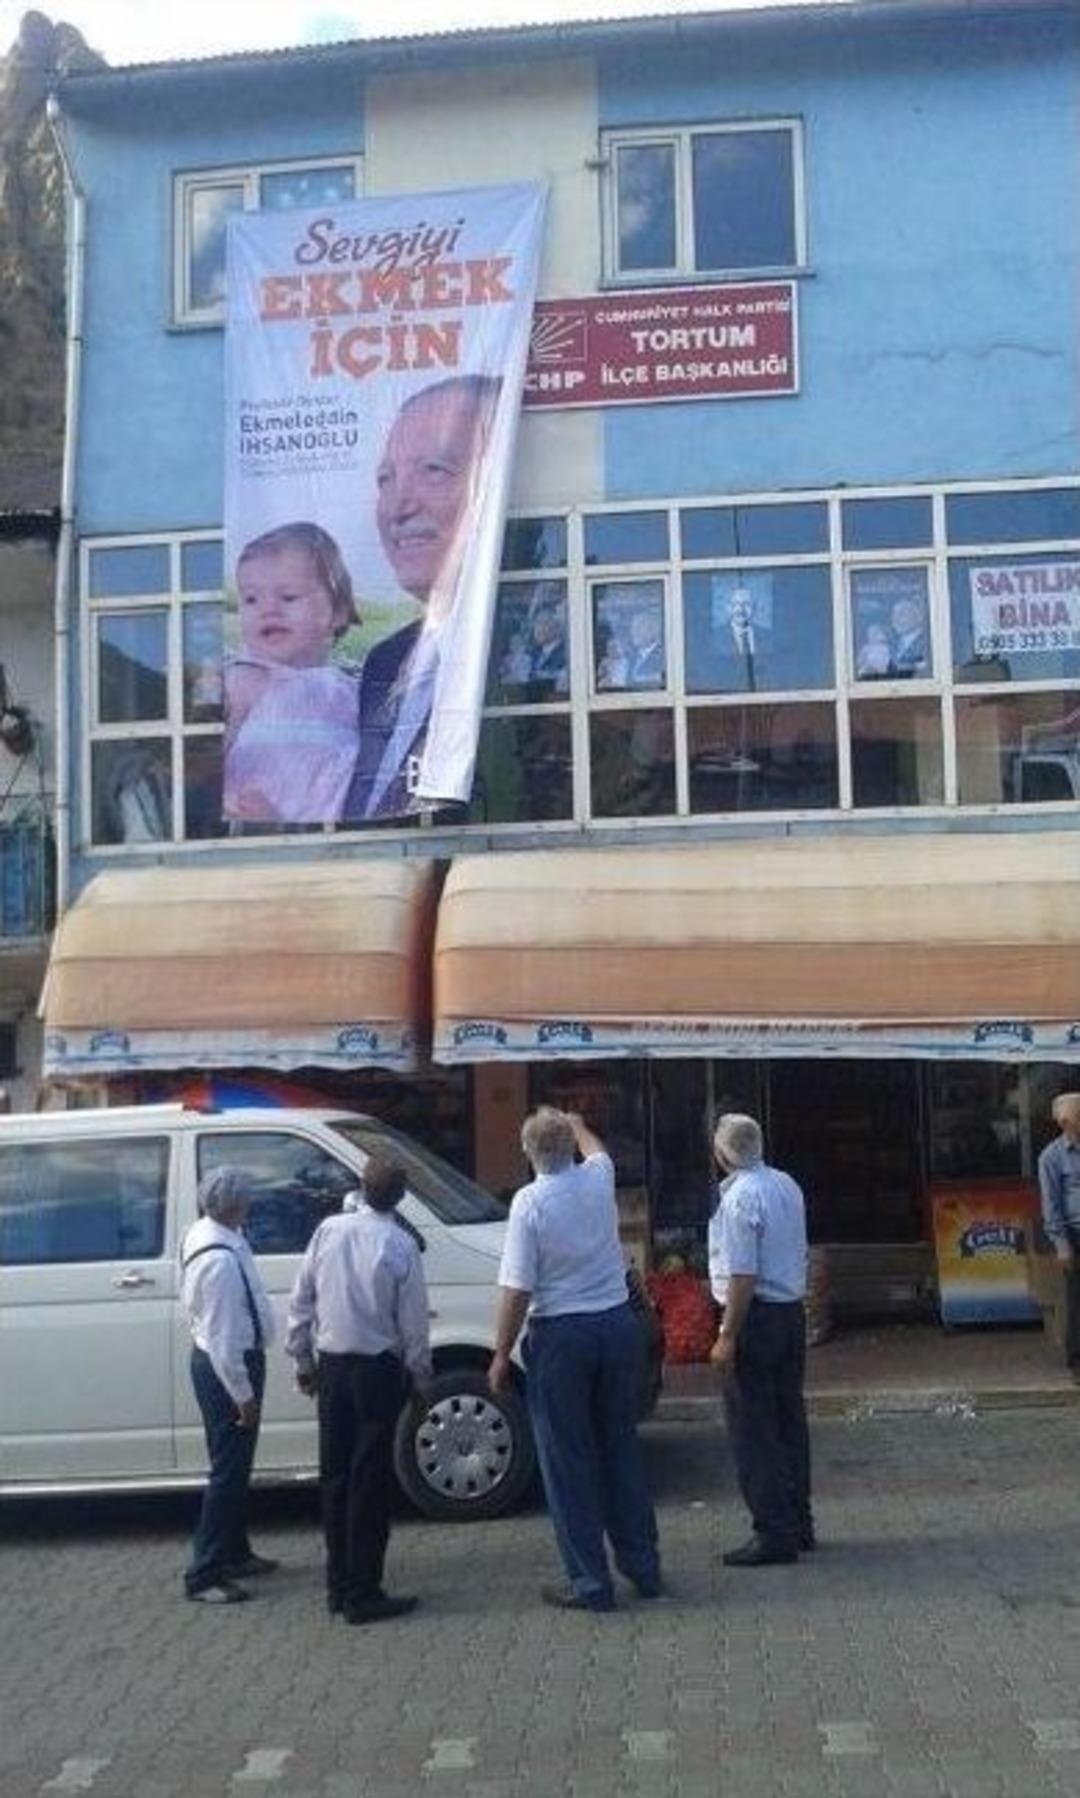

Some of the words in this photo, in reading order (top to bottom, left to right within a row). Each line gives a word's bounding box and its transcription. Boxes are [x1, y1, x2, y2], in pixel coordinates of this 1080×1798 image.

[294, 217, 466, 281] Sevgiyi
[260, 256, 515, 322] EKMEK
[693, 302, 733, 317] HALK
[310, 314, 463, 379] İÇİN
[630, 323, 756, 353] TORTUM
[602, 362, 649, 386] İLÇE
[656, 353, 788, 382] BAŞKANLIĞI
